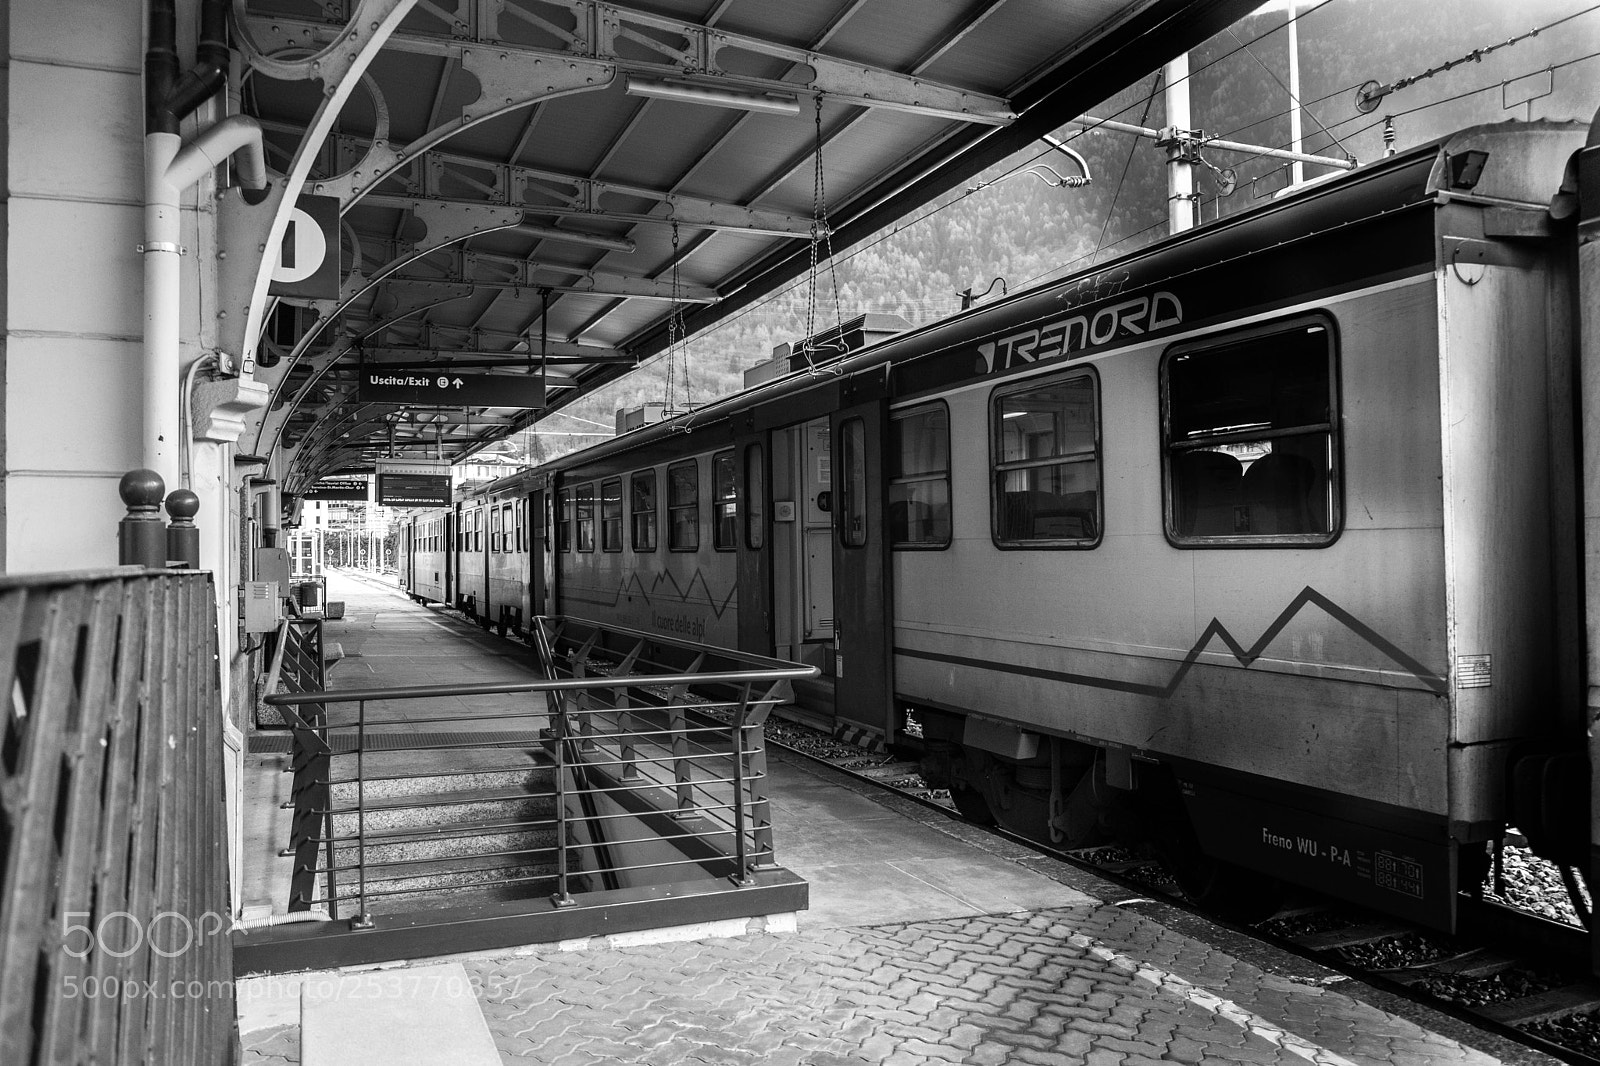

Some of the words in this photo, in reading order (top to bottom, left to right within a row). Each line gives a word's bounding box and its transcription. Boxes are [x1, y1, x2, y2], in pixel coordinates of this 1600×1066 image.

[281, 220, 296, 268] 1
[997, 291, 1183, 369] TRENORD
[370, 375, 430, 387] Uscita/Exit
[674, 614, 691, 635] delle
[692, 617, 706, 643] alpi
[1262, 827, 1292, 850] Freno
[1296, 836, 1317, 857] WU
[1330, 845, 1352, 867] P-A
